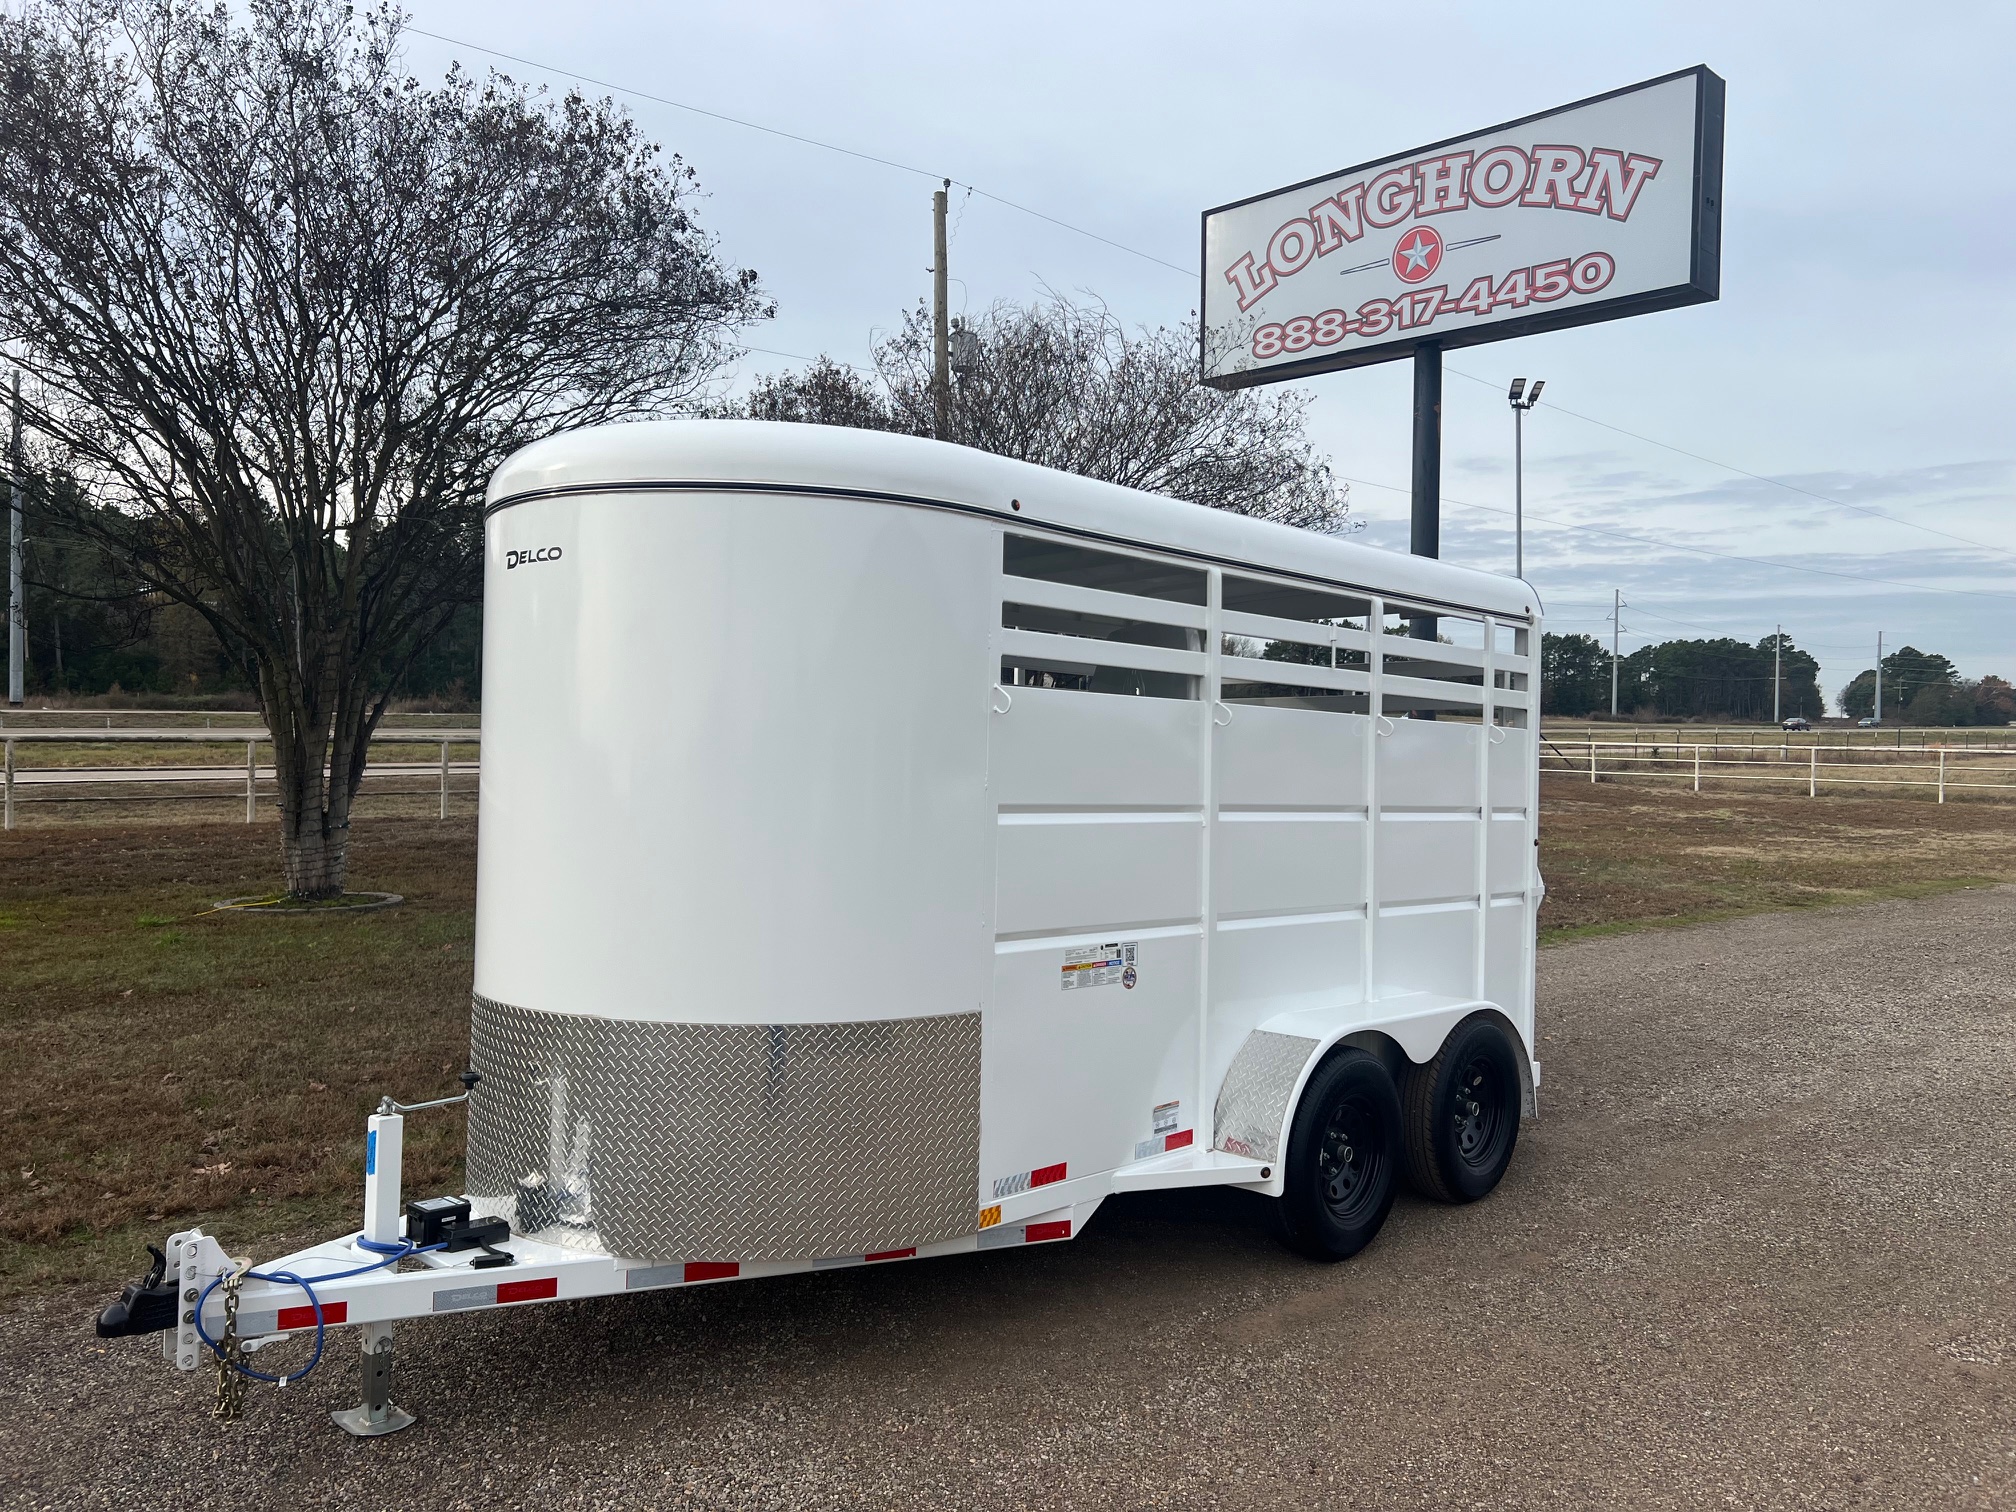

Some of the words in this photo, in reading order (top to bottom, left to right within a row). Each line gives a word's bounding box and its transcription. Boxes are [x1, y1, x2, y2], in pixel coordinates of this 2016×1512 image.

[1225, 144, 1663, 312] LONGHORN
[1252, 251, 1616, 359] 888-317-4450
[506, 546, 563, 570] DELCO
